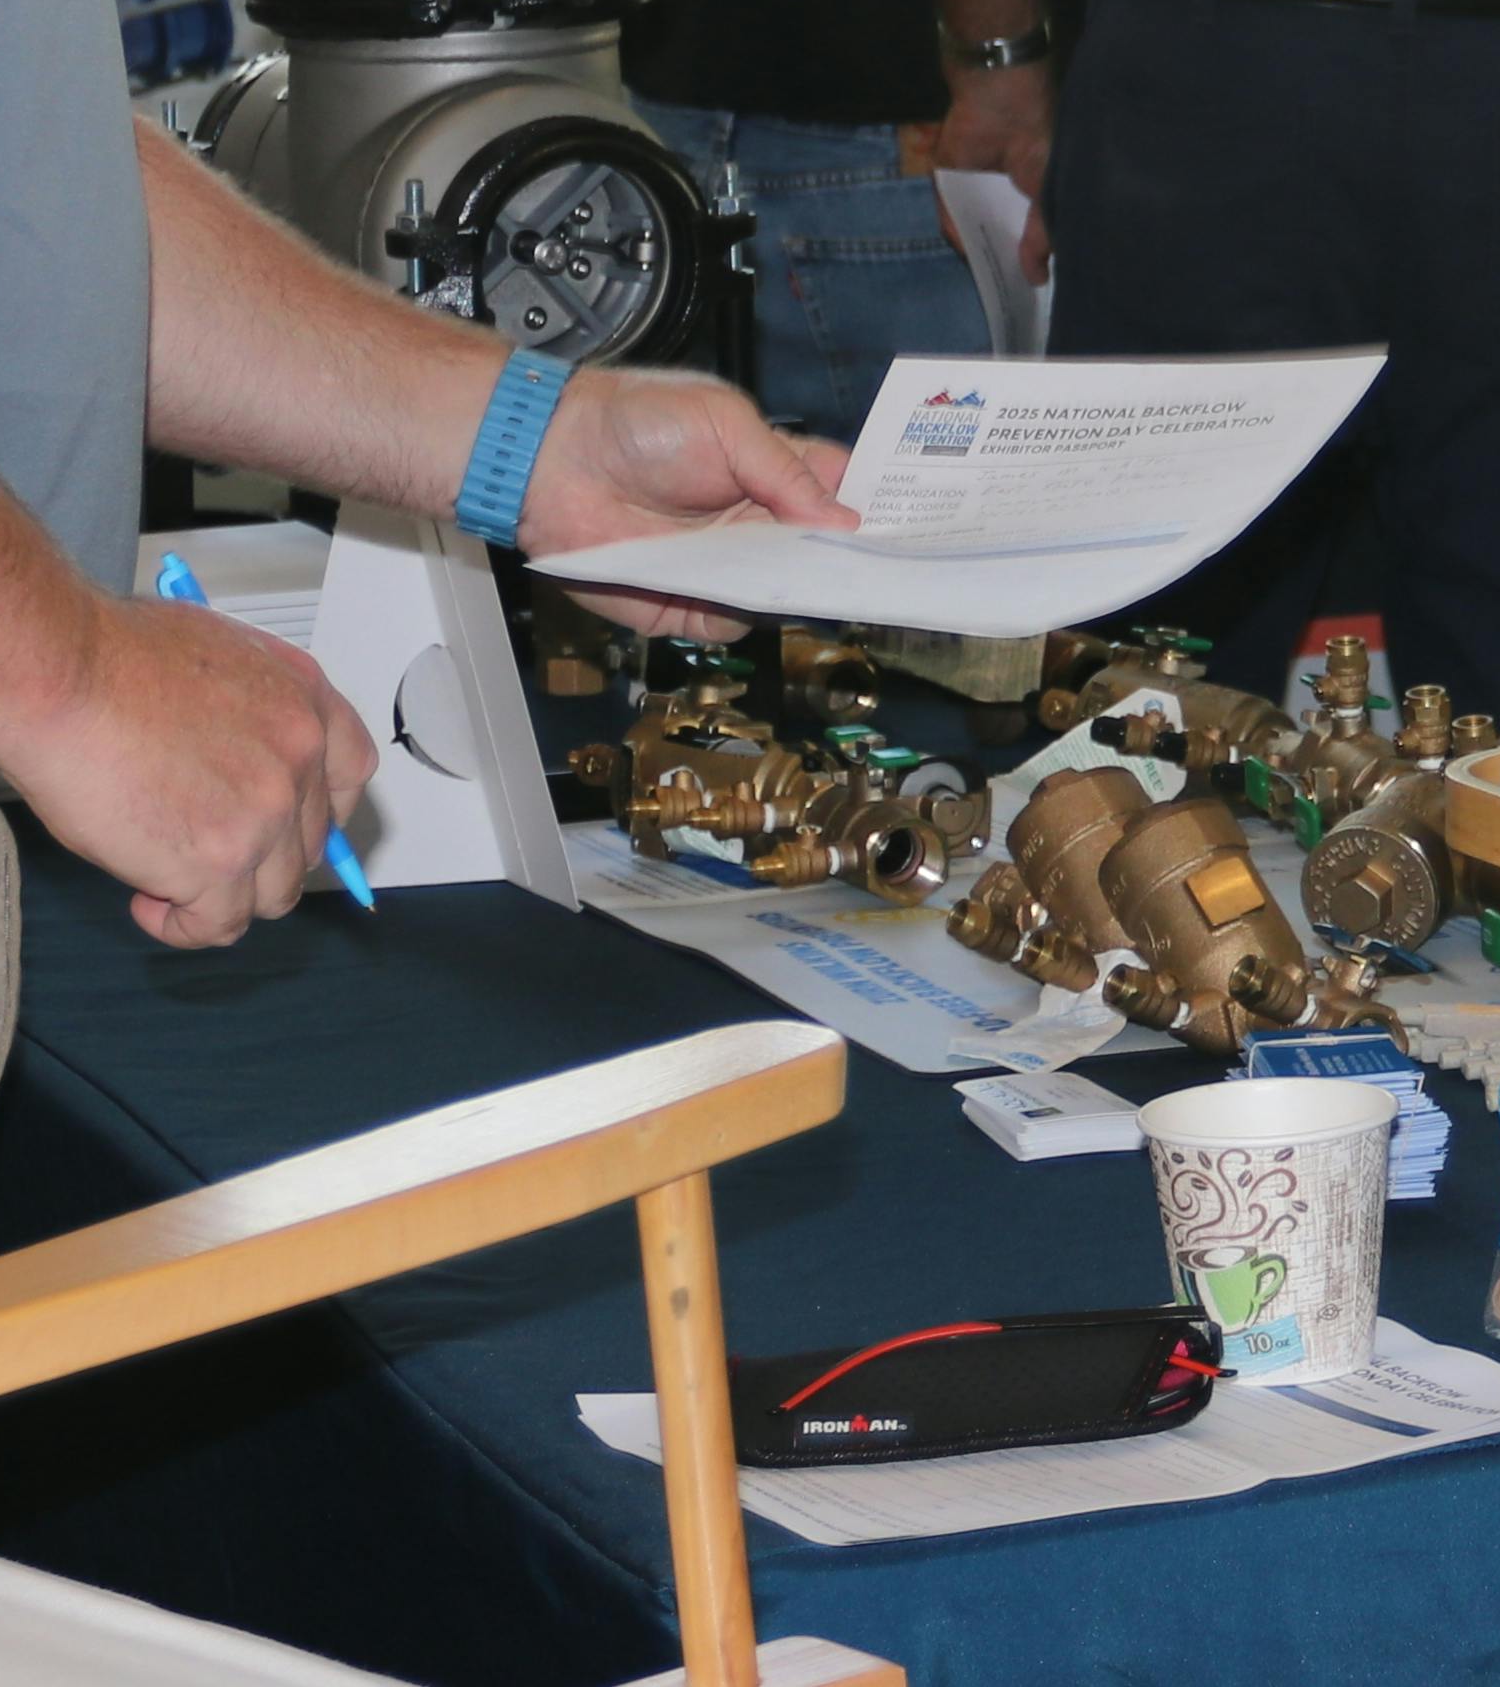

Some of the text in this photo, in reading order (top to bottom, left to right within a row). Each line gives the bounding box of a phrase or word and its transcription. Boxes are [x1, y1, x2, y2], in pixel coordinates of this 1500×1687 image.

[909, 410, 980, 424] NATIONAL
[996, 400, 1247, 422] 2025 NATIONAL BACKFLOW
[904, 422, 980, 435] BACKFLOW
[987, 415, 1276, 442] PREVENTION DAY CELEBRATION
[900, 434, 975, 446] PREVENTION
[980, 443, 1052, 456] EXHIBITOR
[1054, 440, 1127, 454] PASSPORT
[894, 444, 921, 456] DAY
[1244, 1332, 1291, 1355] 10 oz
[1377, 1376, 1411, 1394] DAY
[1381, 1365, 1471, 1401] BACKFLOW
[803, 1414, 899, 1434] IRONMAN
